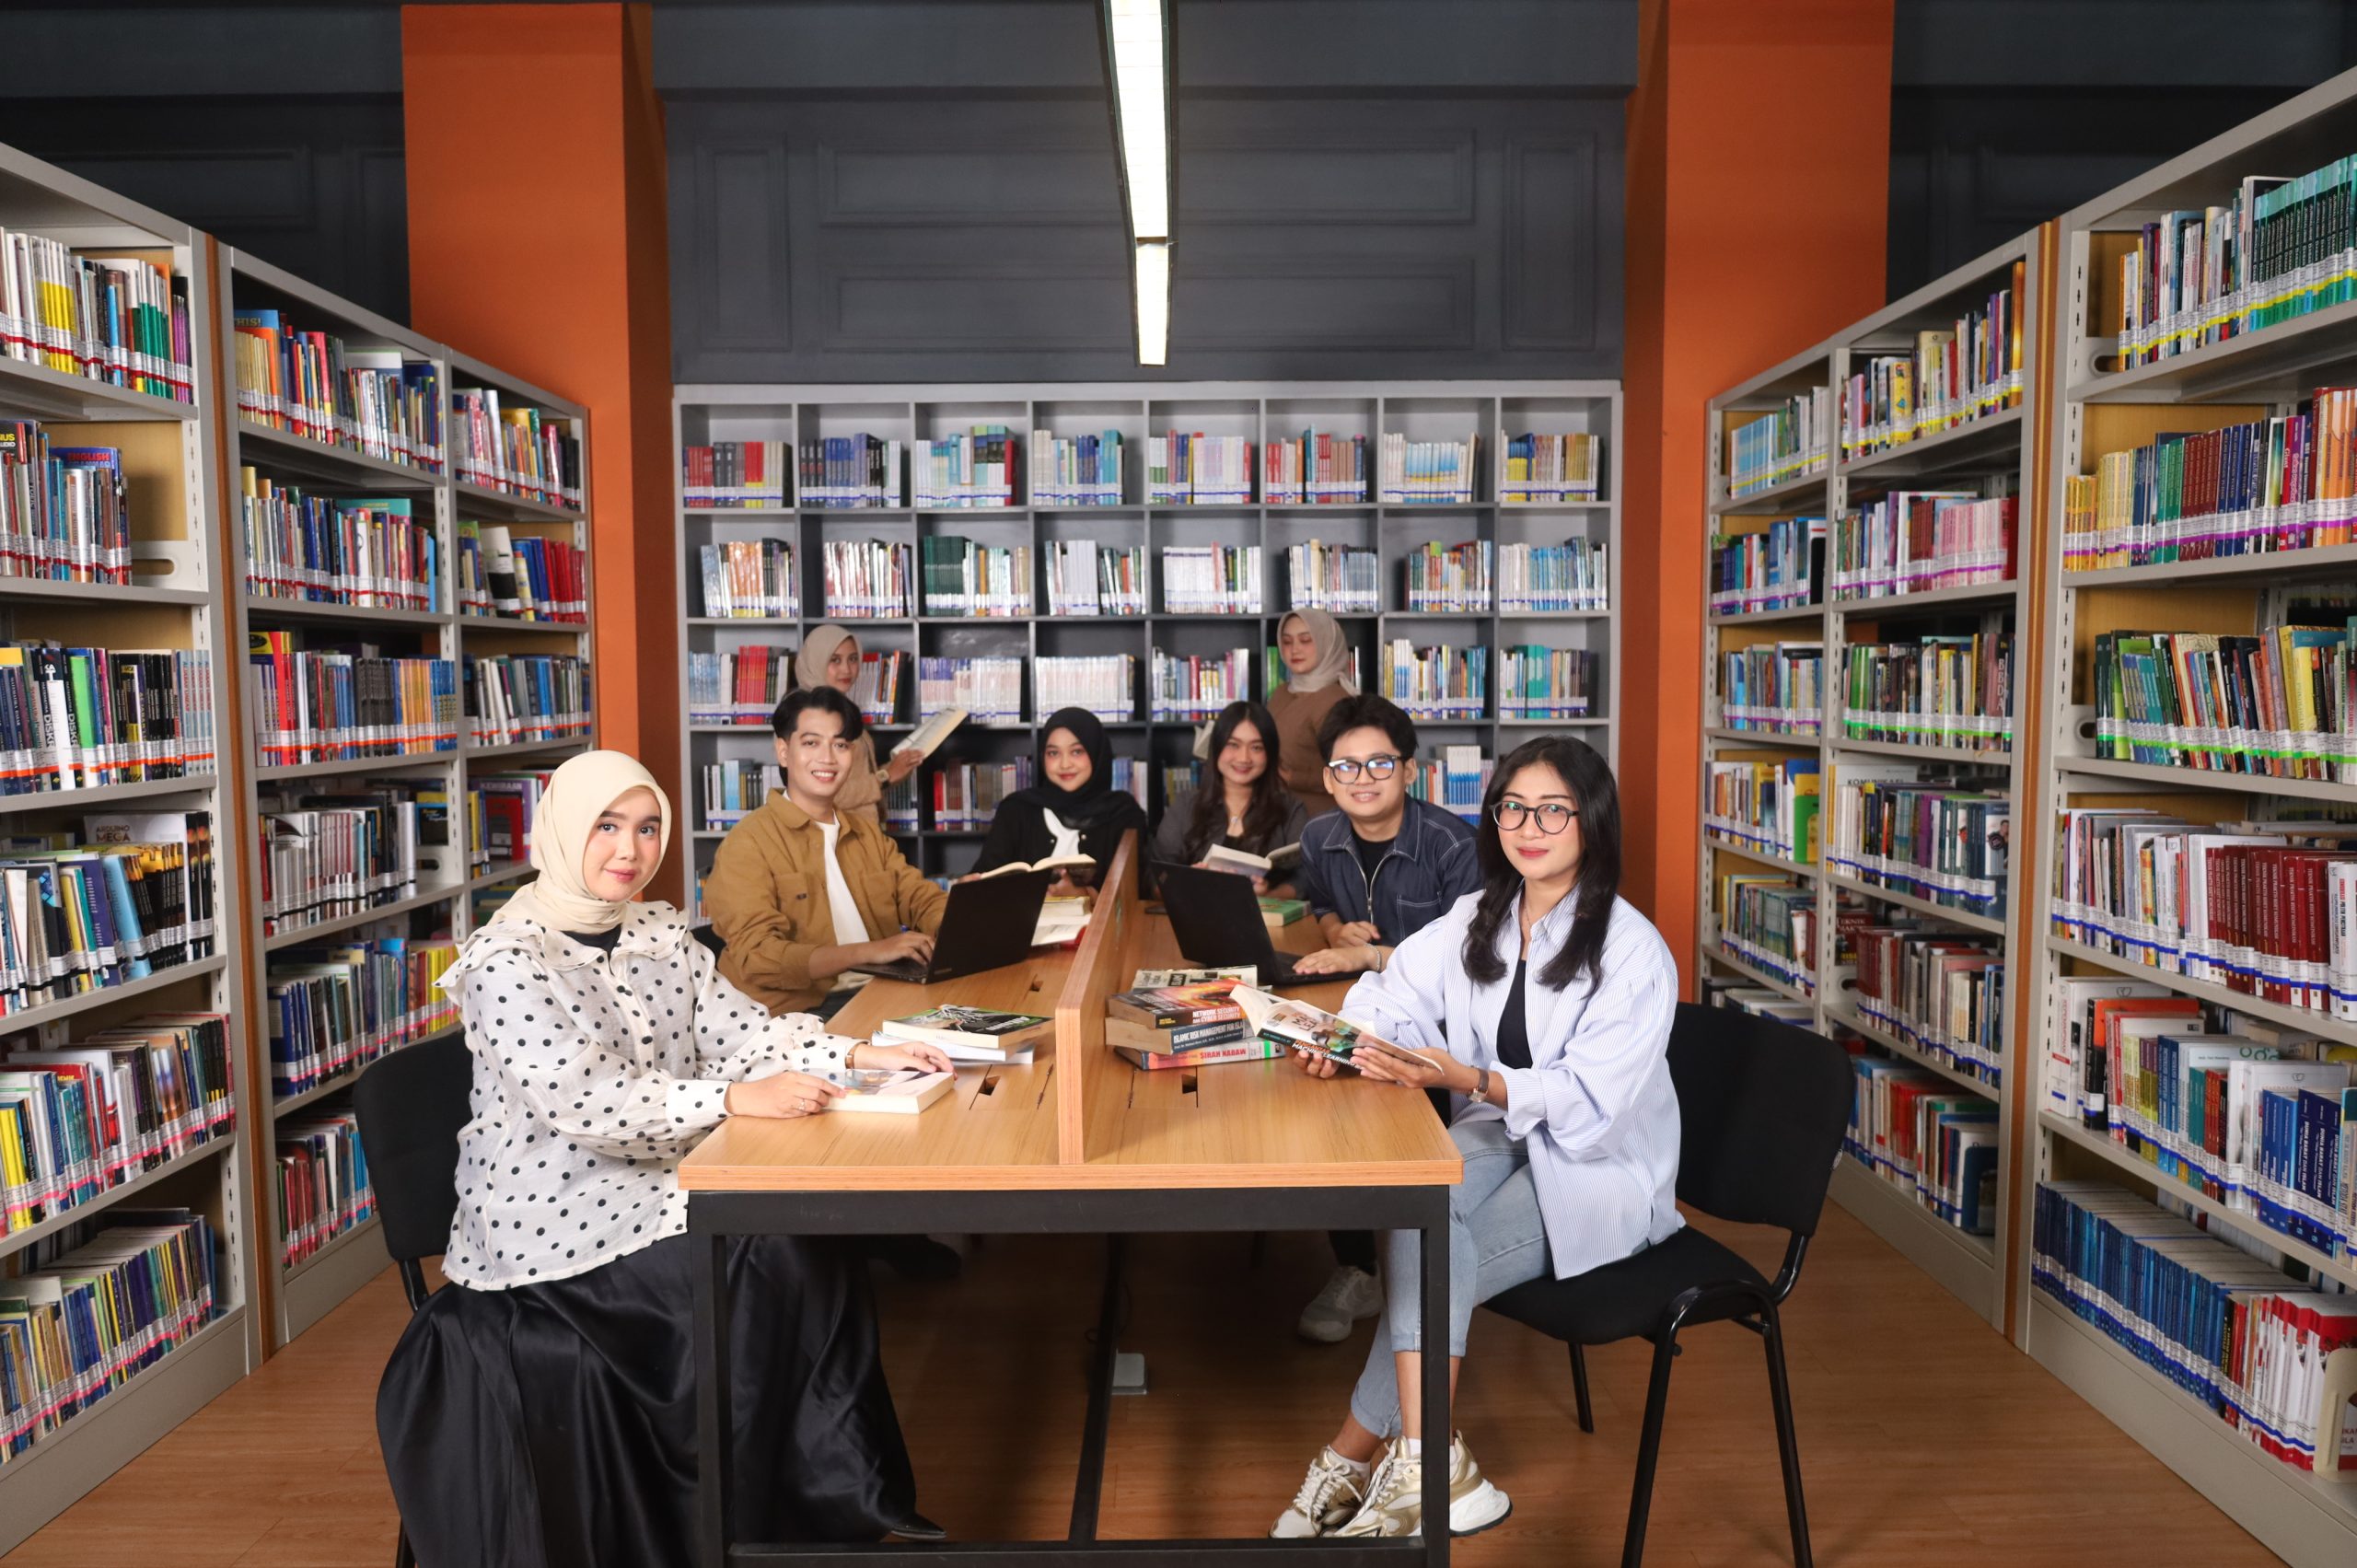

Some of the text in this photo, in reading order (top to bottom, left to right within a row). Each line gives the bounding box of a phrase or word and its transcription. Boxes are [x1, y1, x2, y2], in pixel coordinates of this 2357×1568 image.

[96, 833, 130, 842] MEGA
[1193, 1009, 1216, 1017] NETWORK
[1201, 1015, 1217, 1023] CYBER
[1173, 1033, 1190, 1044] ISLAMIC
[1190, 1031, 1199, 1040] RISK
[1199, 1025, 1226, 1037] MANAGEMENT
[1295, 1040, 1331, 1054] PENGANTAR
